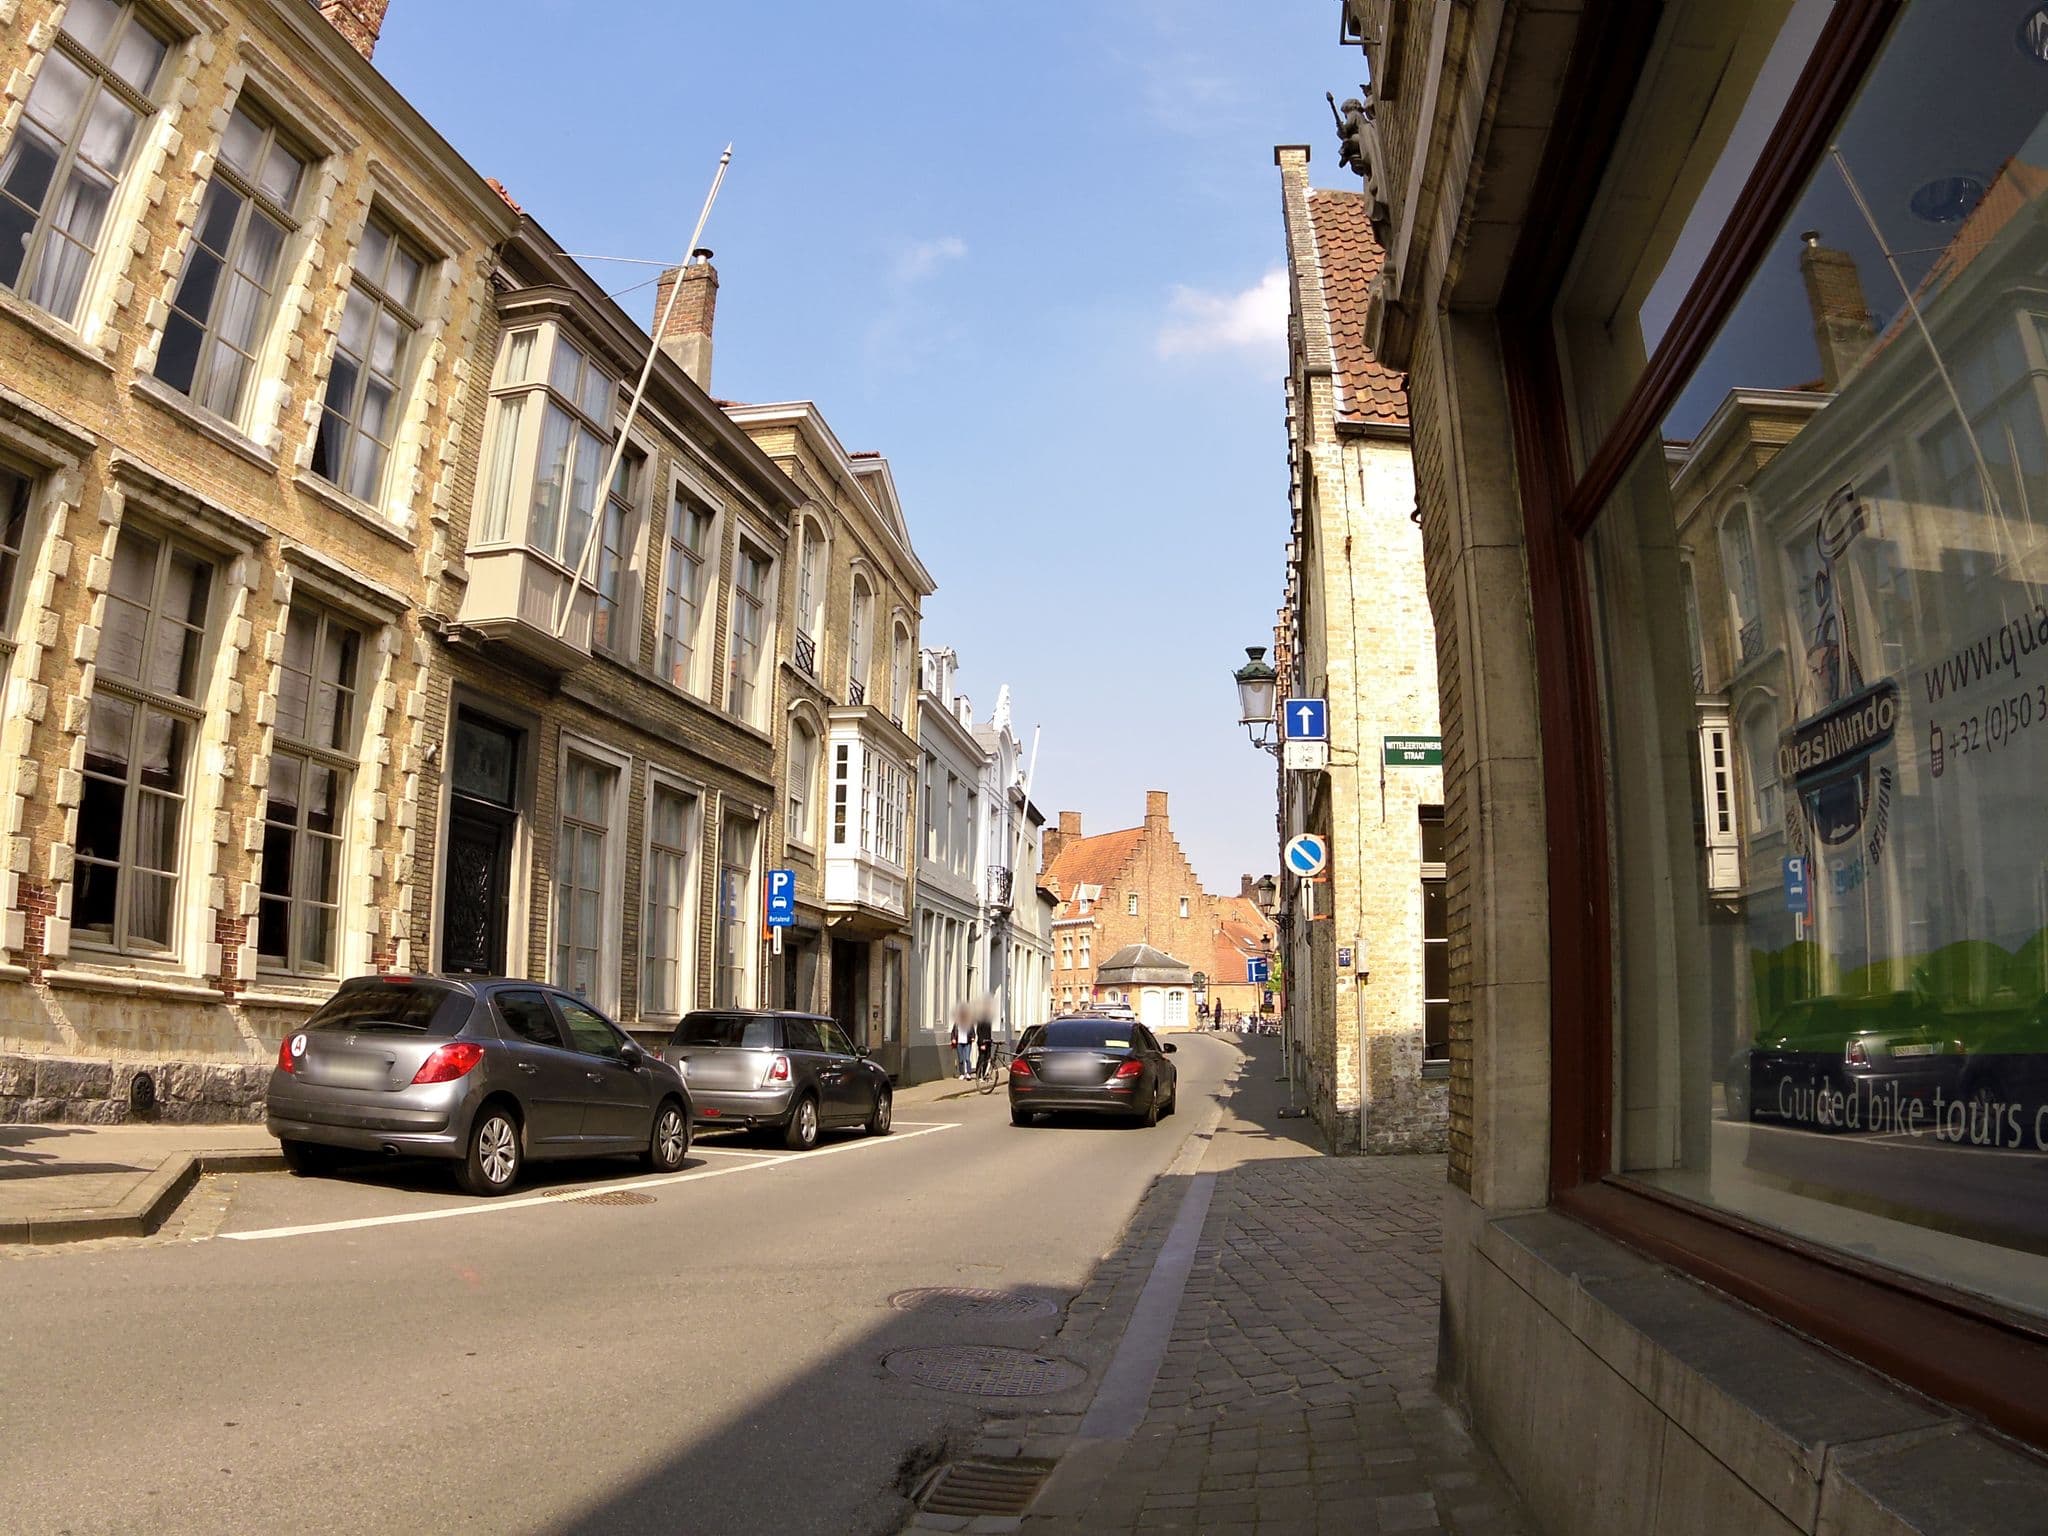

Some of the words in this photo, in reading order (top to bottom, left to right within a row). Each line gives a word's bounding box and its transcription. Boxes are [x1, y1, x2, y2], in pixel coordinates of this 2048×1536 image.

[1403, 751, 1425, 760] STRAAT
[1778, 695, 1894, 776] QuasiMundo
[1949, 716, 1980, 757] +32
[1985, 692, 2031, 752] (0)50
[773, 872, 788, 895] P
[1779, 1076, 1860, 1129] Guided
[1867, 1079, 1924, 1137] bike
[1933, 1086, 2023, 1149] tours
